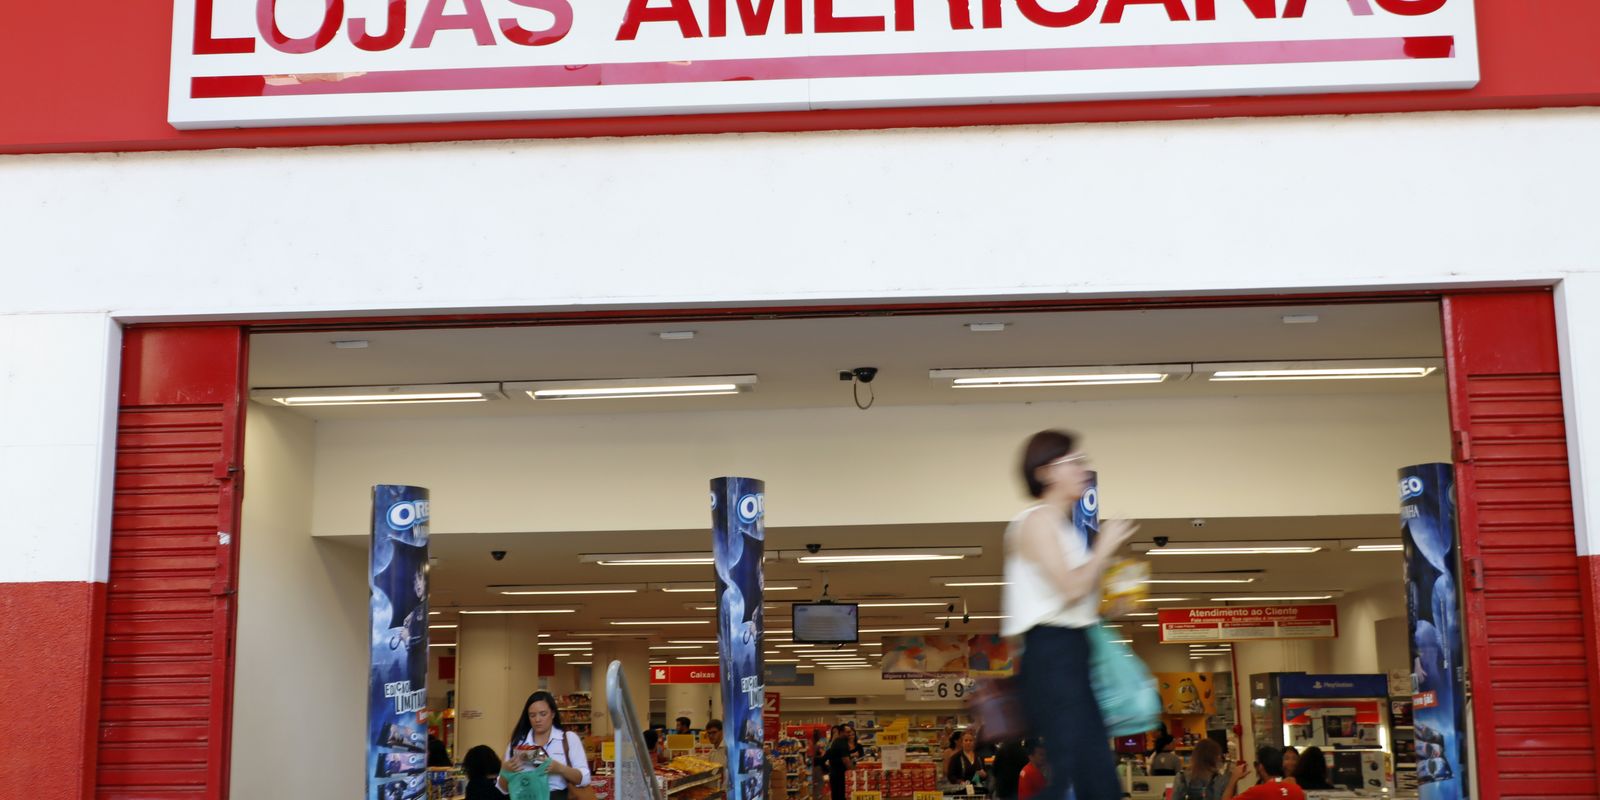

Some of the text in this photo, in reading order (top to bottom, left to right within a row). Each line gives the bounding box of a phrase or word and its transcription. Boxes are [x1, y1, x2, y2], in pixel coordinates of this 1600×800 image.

[1188, 607, 1299, 618] Atendimento ao Cliente
[689, 671, 716, 680] Caixas
